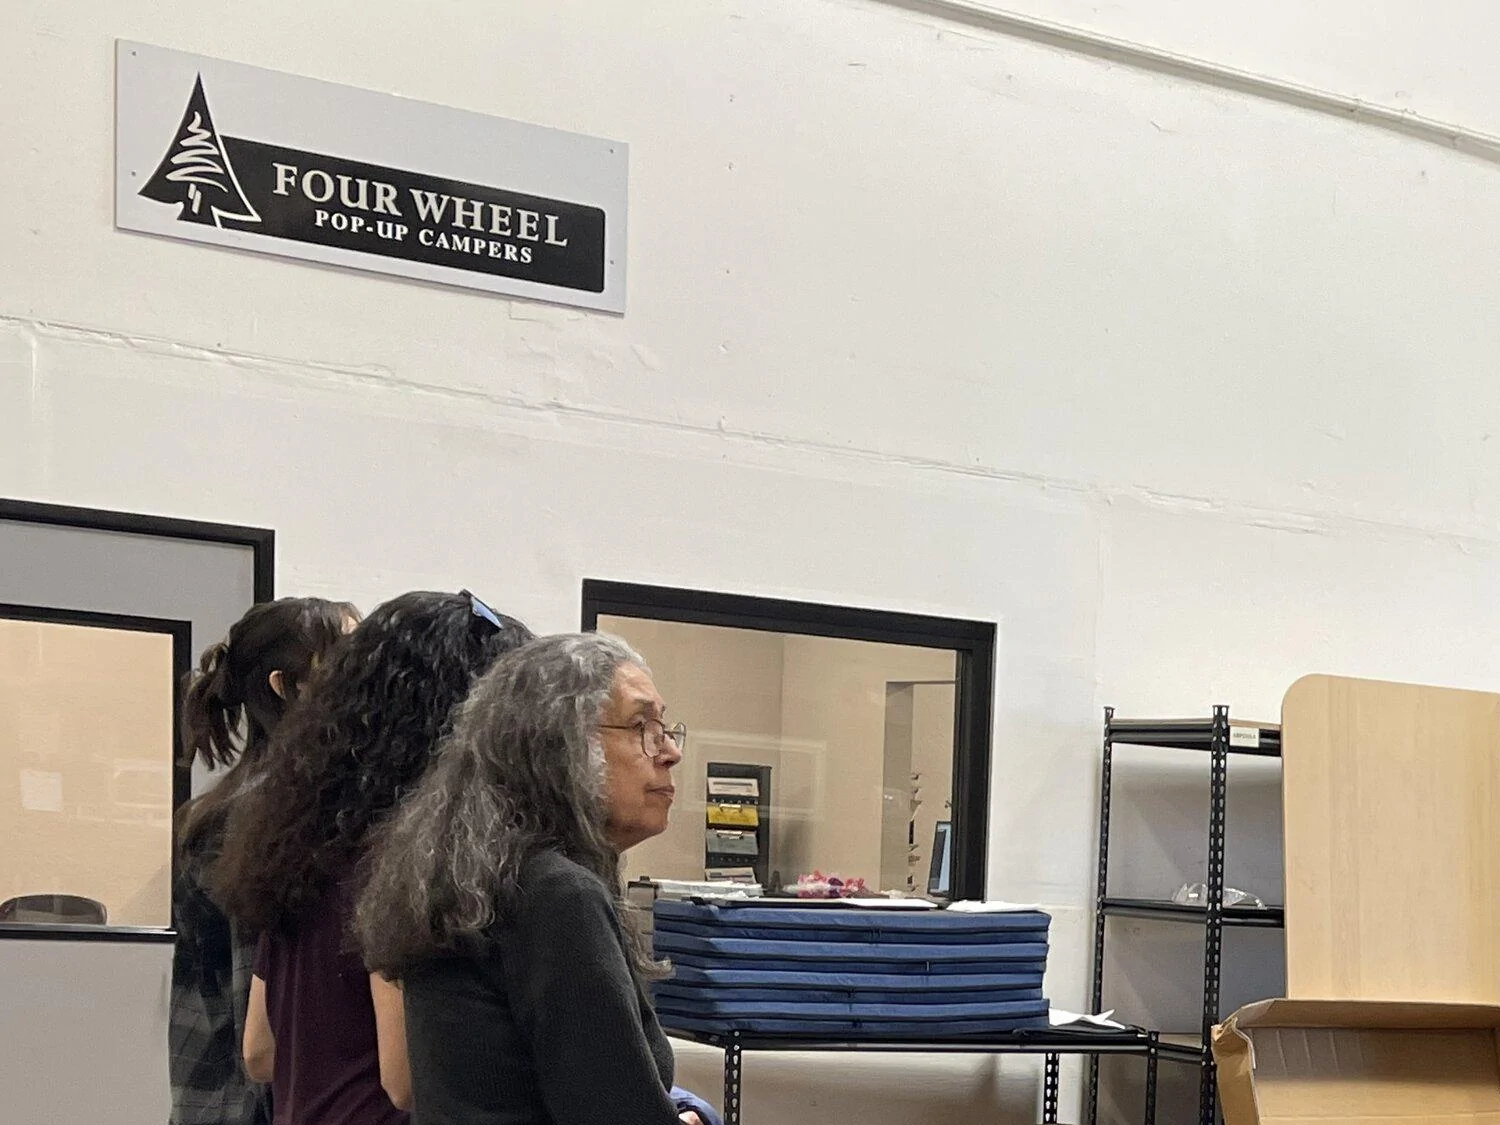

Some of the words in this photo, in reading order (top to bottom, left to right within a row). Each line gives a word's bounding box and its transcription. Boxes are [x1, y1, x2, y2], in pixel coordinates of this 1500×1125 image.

[272, 162, 402, 217] FOUR
[410, 188, 568, 246] WHEEL
[314, 209, 409, 243] POP-UP
[418, 228, 533, 264] CAMPERS
